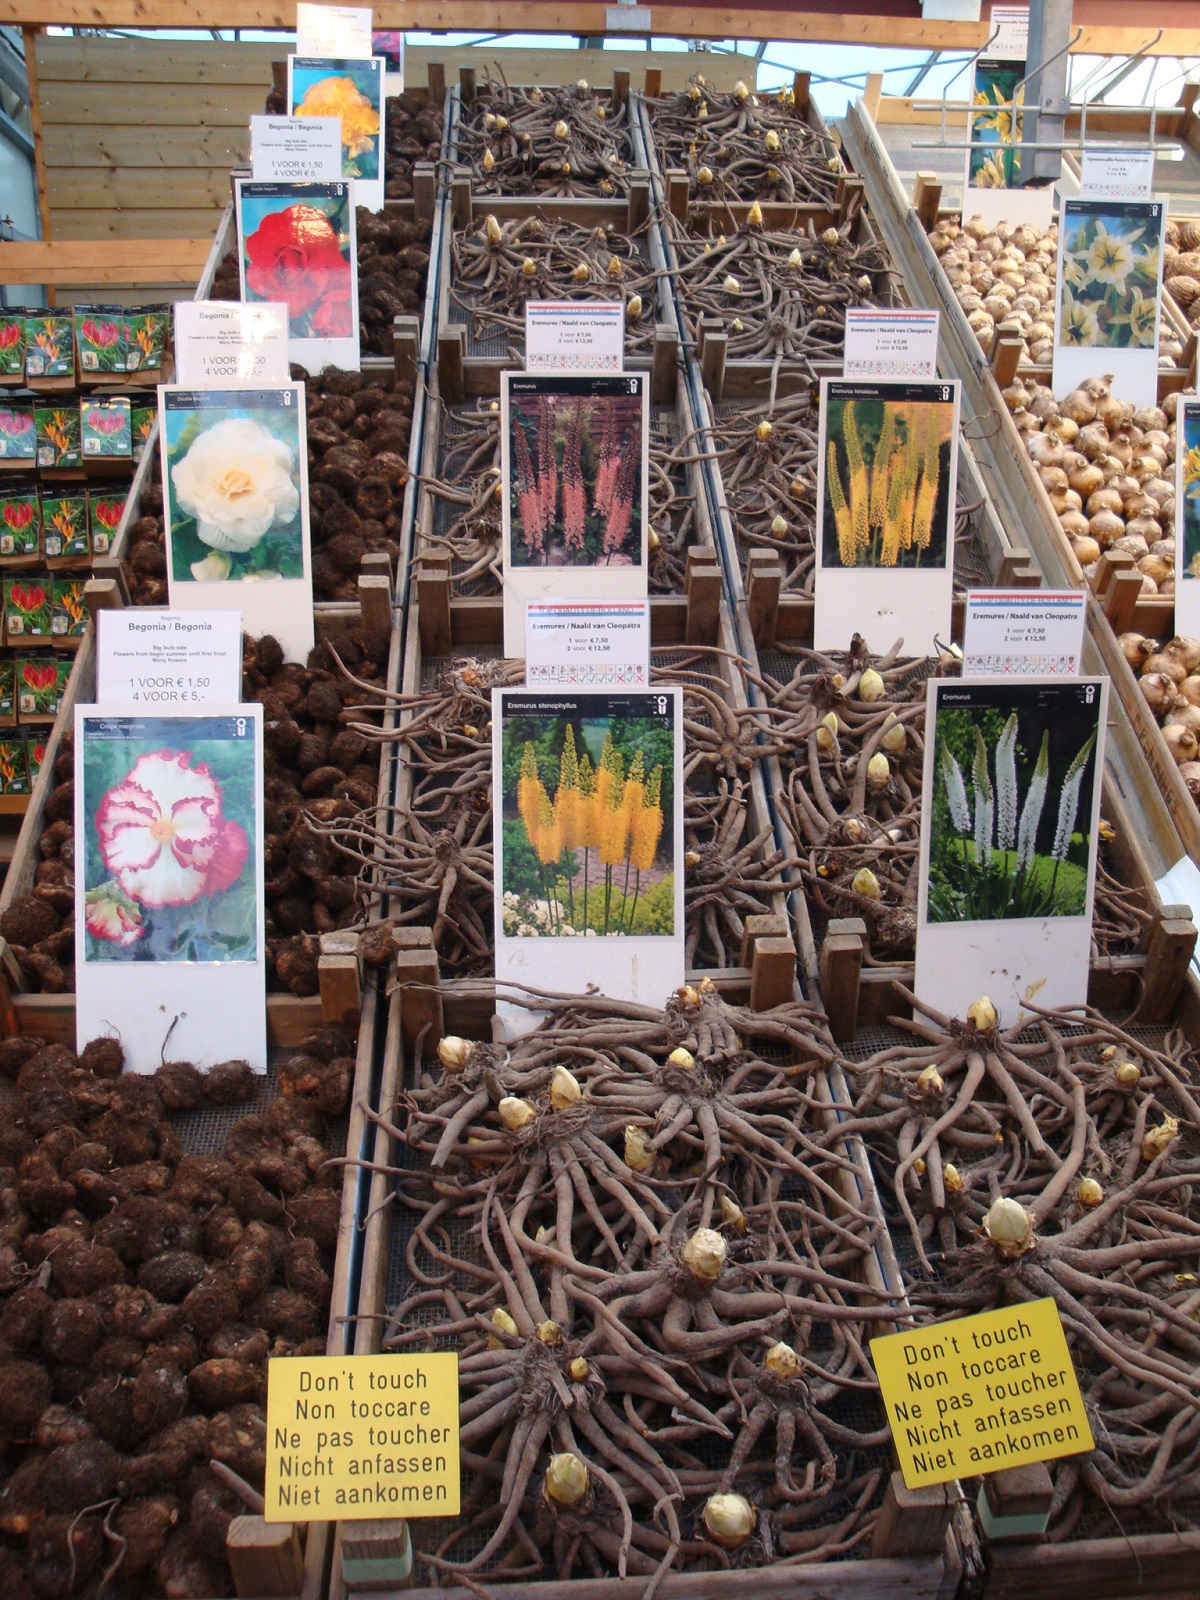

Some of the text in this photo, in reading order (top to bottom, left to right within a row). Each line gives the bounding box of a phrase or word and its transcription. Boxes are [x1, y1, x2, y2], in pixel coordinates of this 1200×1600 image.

[128, 623, 166, 632] Begonia
[174, 623, 212, 632] Begonia
[606, 622, 641, 631] Cleopatra
[130, 678, 210, 688] 1 VOOR € 1,50
[133, 692, 204, 702] 4 VOOR € 5,-
[903, 1320, 1032, 1365] Don't touch
[300, 1368, 427, 1392] Don't touch
[907, 1349, 1041, 1392] Non toccare
[894, 1370, 1067, 1423] Ne pas toucher
[296, 1399, 430, 1420] Non toccare
[906, 1397, 1072, 1447] Nicht anfassen
[275, 1424, 450, 1453] Ne pas toucher
[912, 1424, 1079, 1474] Niet aankomen
[279, 1453, 446, 1477] Nicht anfassen
[278, 1482, 447, 1507] Niet aankomen
